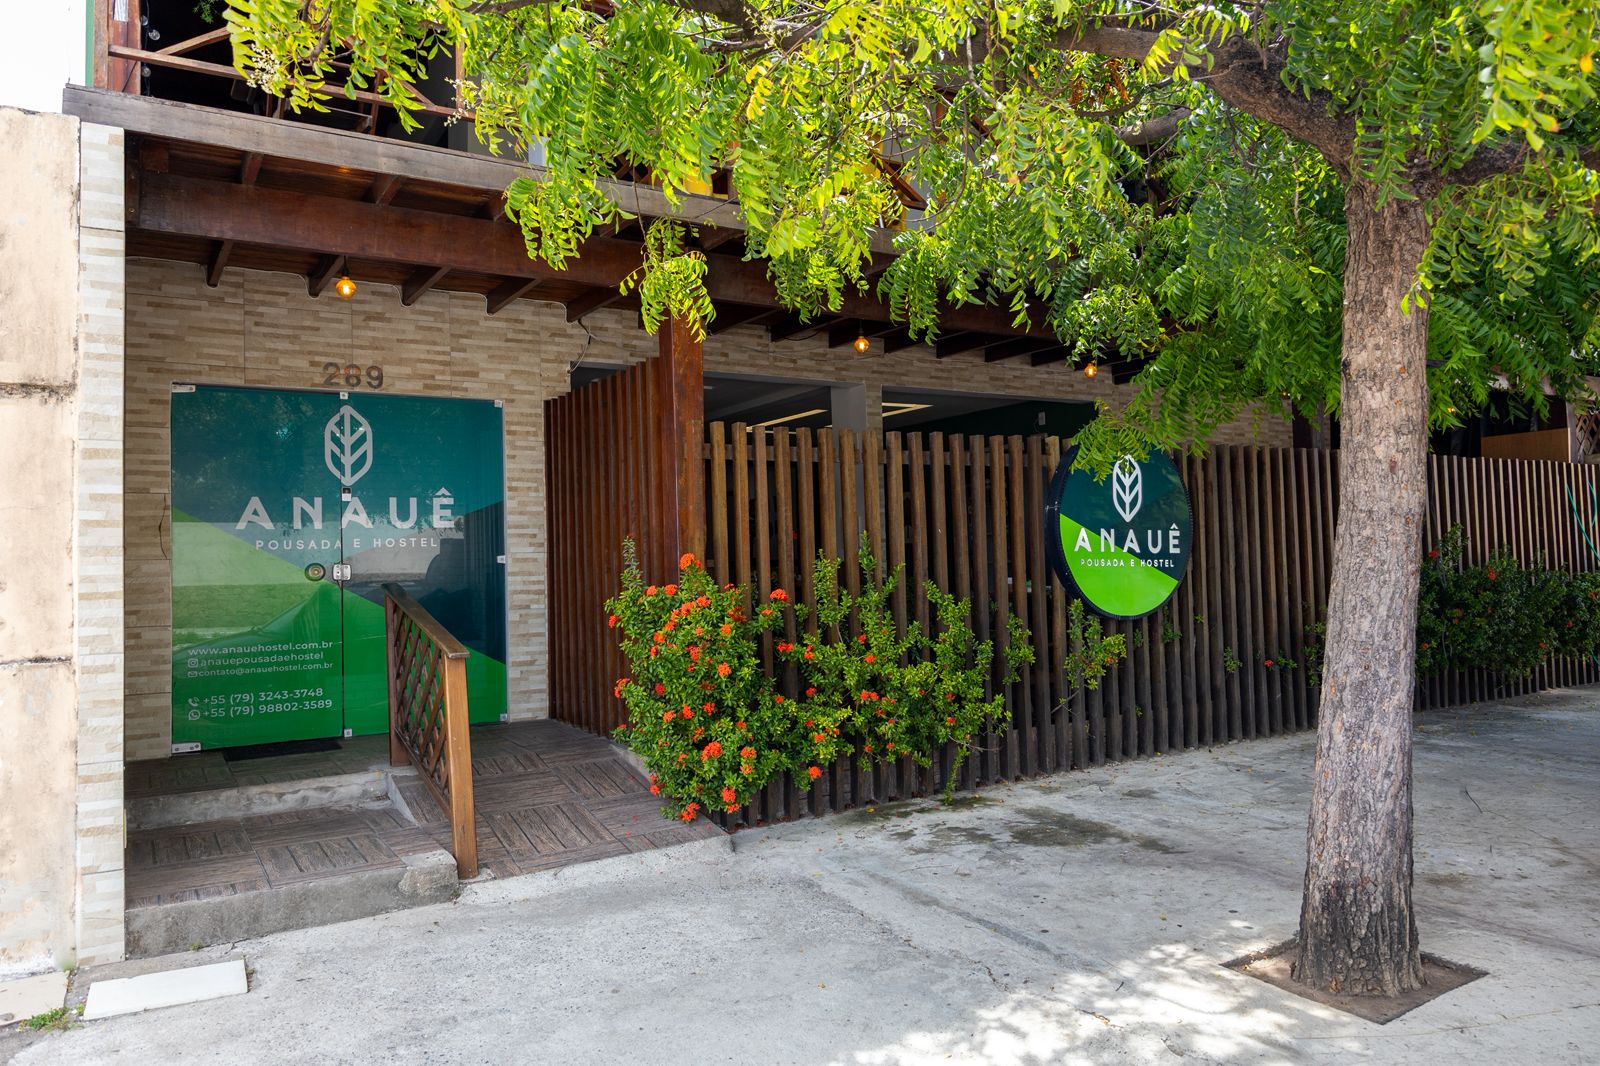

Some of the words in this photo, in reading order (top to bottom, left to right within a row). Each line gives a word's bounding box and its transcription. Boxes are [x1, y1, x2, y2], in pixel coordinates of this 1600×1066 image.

[322, 361, 384, 389] 289
[235, 487, 455, 530] ANAUÊ
[255, 538, 342, 551] POUSADA
[353, 538, 361, 548] E
[373, 537, 438, 548] HOSTEL
[1073, 523, 1181, 554] ANAUÊ
[1080, 558, 1125, 567] POUSADA
[1130, 559, 1135, 567] E
[1140, 559, 1175, 568] HOSTEL
[188, 641, 333, 656] www.anauehostel.com.br
[200, 652, 324, 667] anauepousadaehostel
[198, 662, 333, 677] contato@anauehostel.com.br
[203, 695, 226, 705] +55
[230, 692, 255, 705] (79)
[258, 687, 324, 702] 3243-3748
[203, 708, 226, 718] +55
[230, 705, 255, 718] (79)
[258, 699, 333, 714] 98802-3589
